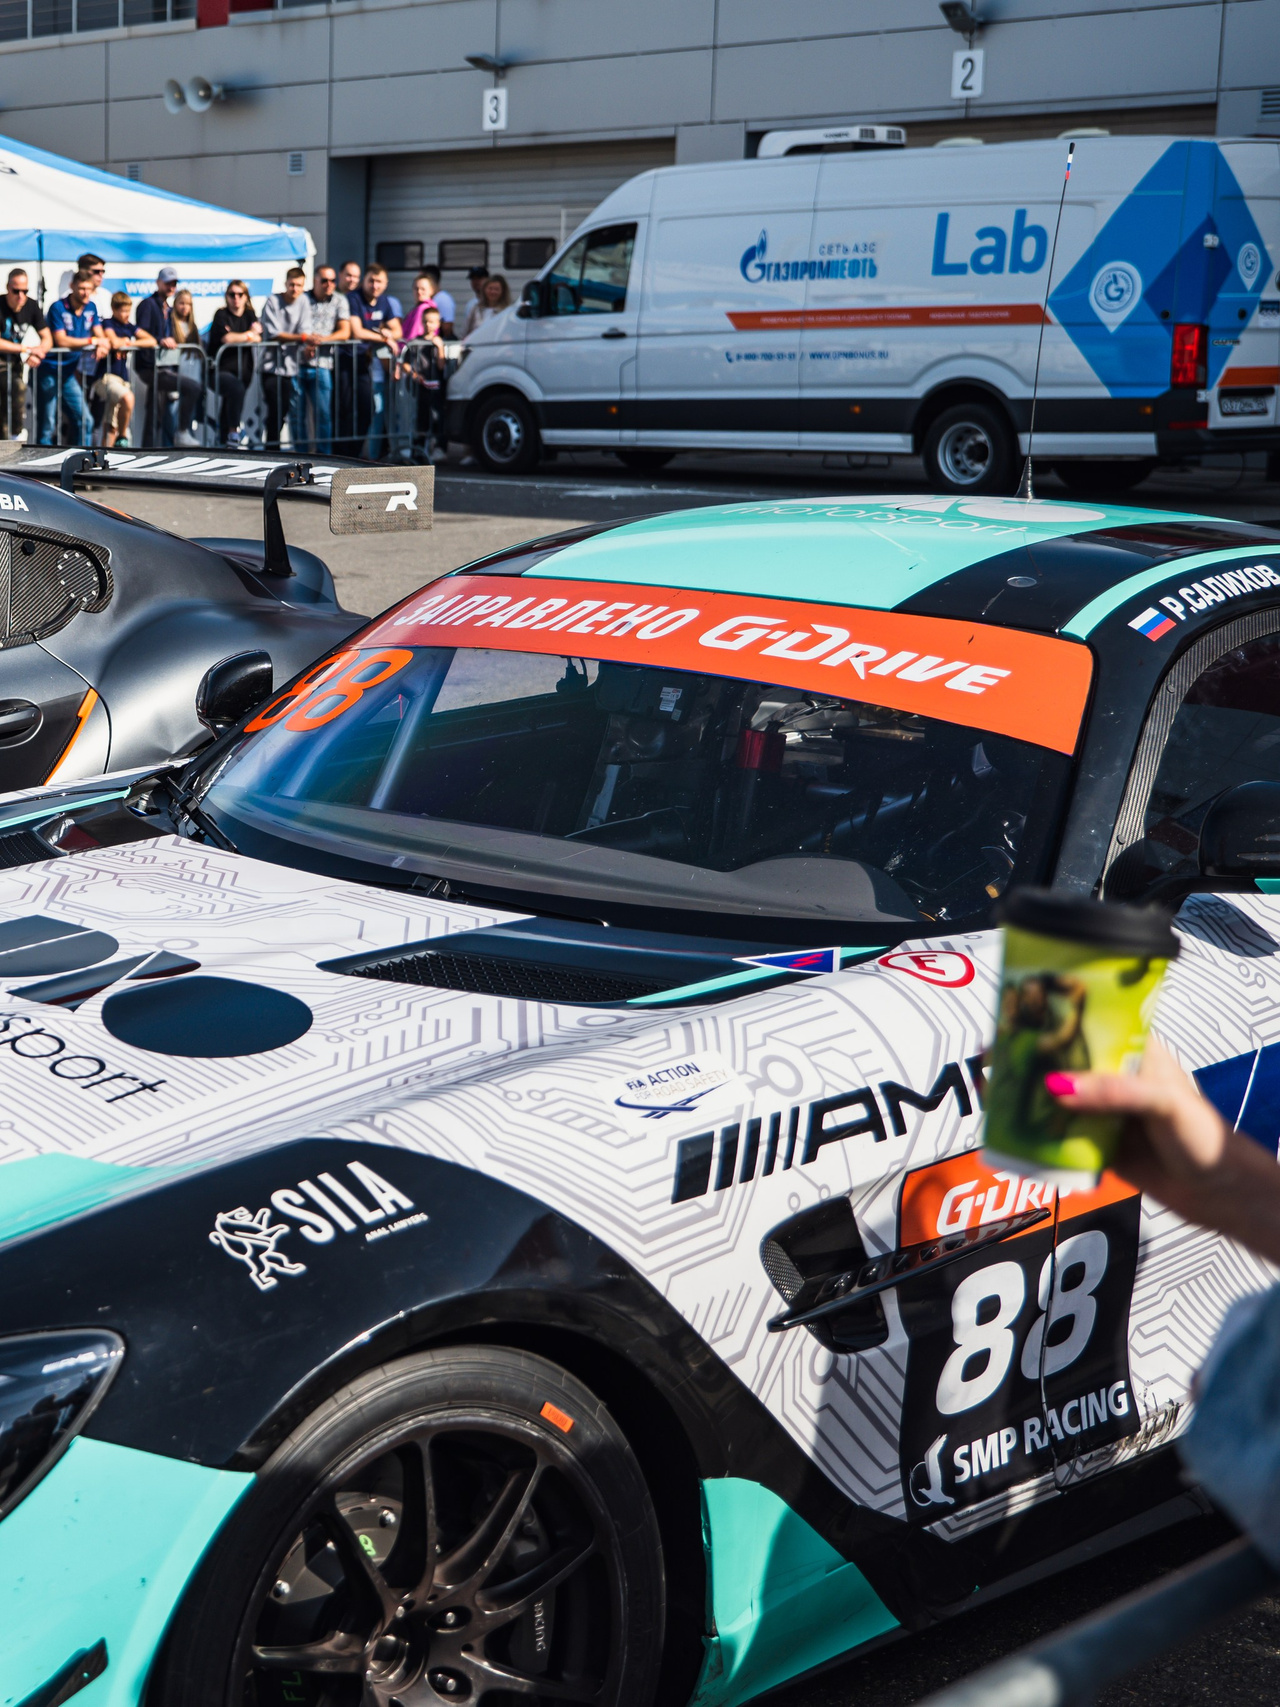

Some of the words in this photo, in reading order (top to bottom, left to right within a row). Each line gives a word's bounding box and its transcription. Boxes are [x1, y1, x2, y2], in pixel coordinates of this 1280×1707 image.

[961, 58, 975, 91] 2
[488, 95, 501, 124] 3
[819, 243, 849, 256] СЕТЬ
[851, 242, 877, 254] АЗС
[931, 208, 1049, 277] Lab
[766, 257, 878, 283] ГАЗПРОМНЕФТЬ
[721, 505, 1028, 537] motorsport
[1158, 564, 1280, 621] Р.САЛИХОВ
[393, 594, 701, 642] ЗАПРАВЛЕНО
[243, 648, 414, 733] 88
[647, 1062, 701, 1086] ACTION
[652, 1082, 687, 1098] ROAD
[685, 1069, 728, 1089] SAFETY
[270, 1160, 415, 1244] SILA
[935, 1229, 1109, 1416] 88
[953, 1426, 1018, 1484] SMP
[1023, 1380, 1130, 1455] RACING
